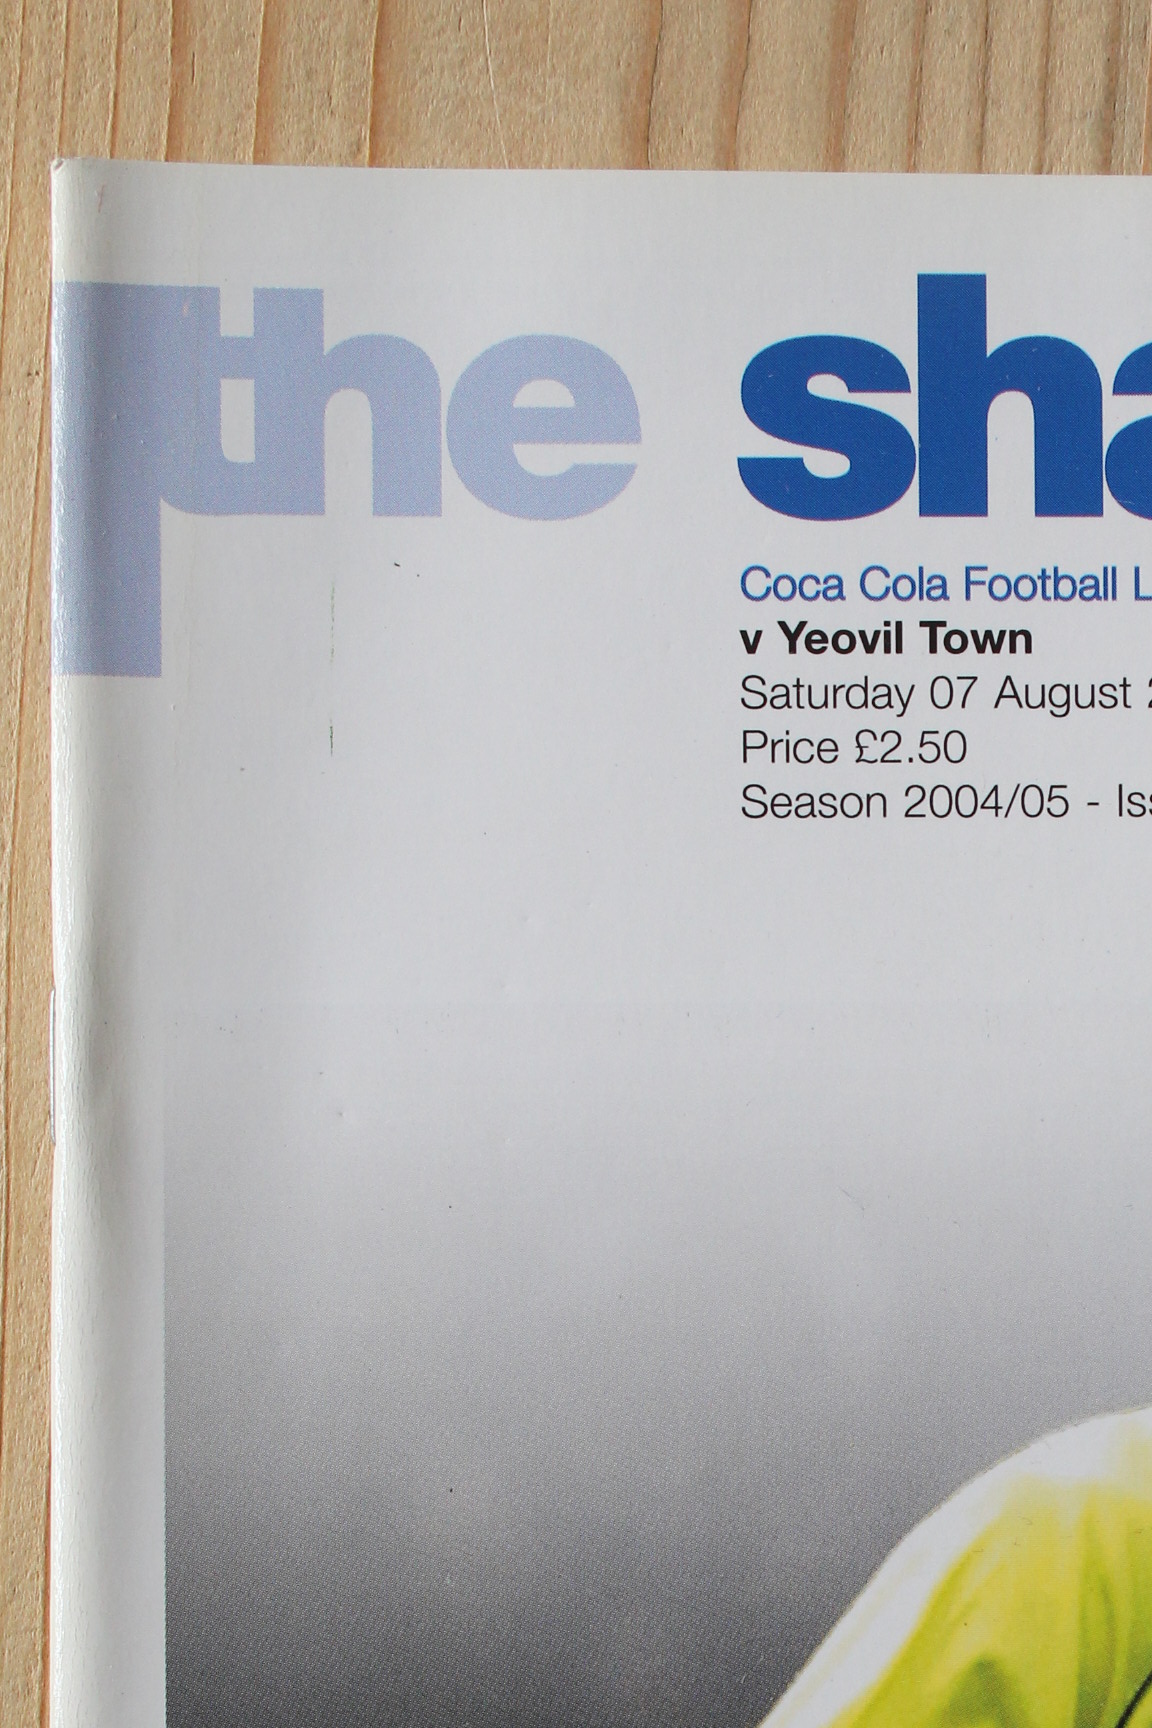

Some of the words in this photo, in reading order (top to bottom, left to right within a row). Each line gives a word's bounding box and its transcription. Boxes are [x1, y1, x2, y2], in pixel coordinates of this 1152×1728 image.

[114, 285, 642, 522] the
[741, 565, 846, 602] Coca
[860, 566, 950, 602] Cola
[965, 566, 1117, 602] Football
[739, 630, 763, 654] v
[777, 621, 903, 654] Yeovil
[919, 621, 1032, 654] Town
[741, 675, 915, 718] Saturday
[930, 676, 978, 709] 07
[994, 675, 1131, 718] August
[743, 729, 839, 764] Price
[855, 729, 967, 764] £2.50
[742, 784, 886, 819] Season
[904, 784, 1069, 819] 2004/05
